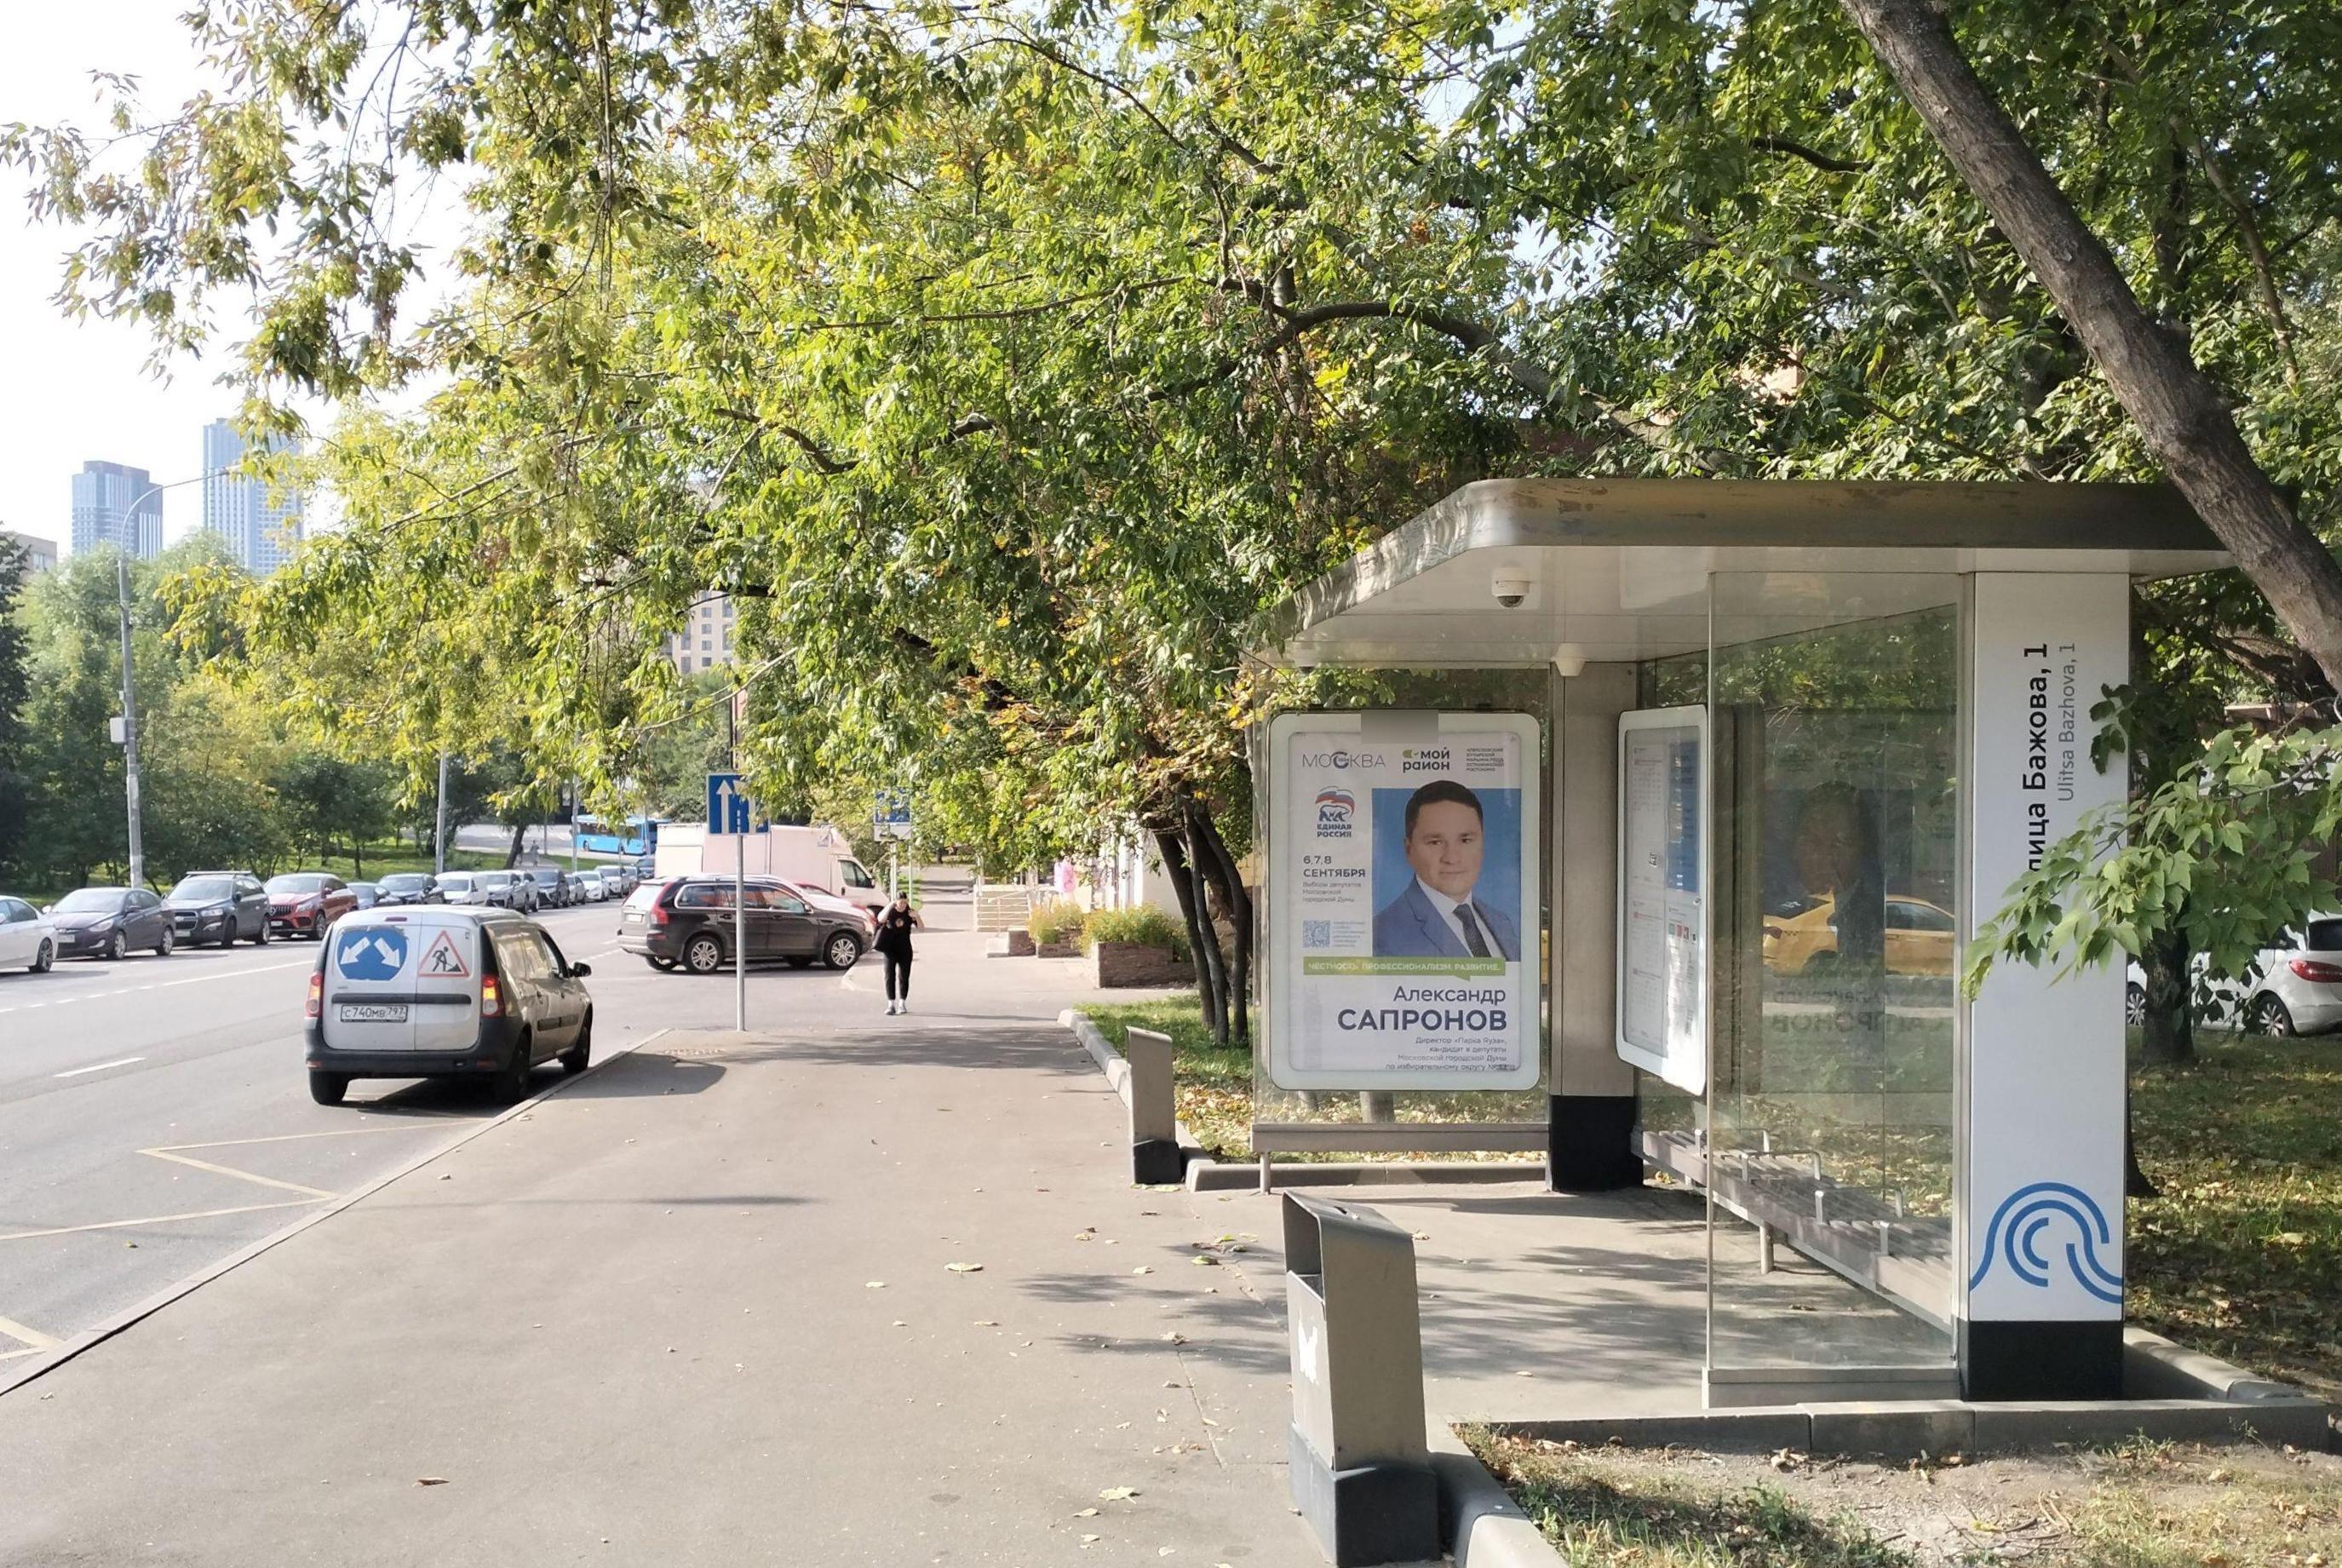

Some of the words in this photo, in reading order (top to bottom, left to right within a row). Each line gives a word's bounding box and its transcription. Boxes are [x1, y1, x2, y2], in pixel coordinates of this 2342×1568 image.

[2023, 643, 2048, 658] 1
[2058, 642, 2075, 652] 1
[2057, 658, 2078, 743] Bazhova,
[2023, 668, 2052, 790] Бажова,
[1301, 750, 1386, 769] МОСКВА
[1421, 746, 1450, 760] мой
[2057, 750, 2075, 801] Ulitsa
[2029, 803, 2050, 873] лица
[1303, 869, 1366, 878] СЕНТЯБРЯ
[1392, 985, 1507, 1006] Александр
[1337, 1008, 1507, 1031] САПРОНОВ
